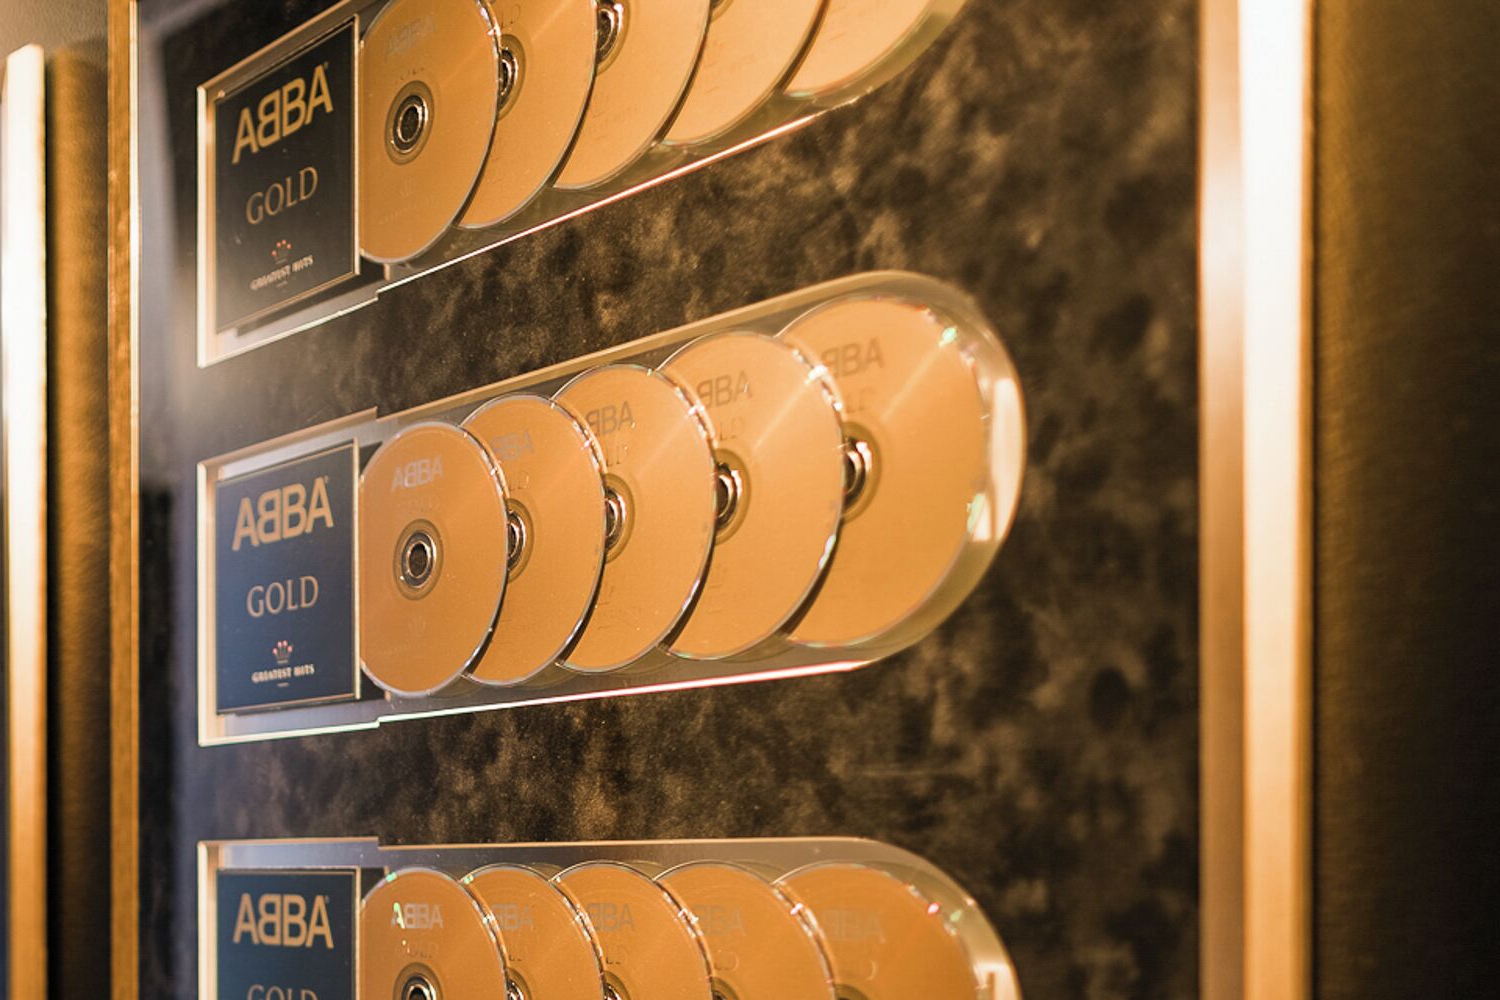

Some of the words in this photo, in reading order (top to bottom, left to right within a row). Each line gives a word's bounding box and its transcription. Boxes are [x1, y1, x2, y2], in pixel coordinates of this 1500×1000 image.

[232, 63, 334, 164] ABBA
[246, 166, 319, 225] GOLD
[822, 337, 885, 379] BBA
[698, 370, 752, 410] BBA
[585, 400, 635, 438] BBA
[390, 455, 445, 493] ABBA
[232, 475, 334, 551] ABBA
[246, 575, 319, 618] GOLD
[233, 893, 334, 949] ABBA
[391, 902, 444, 930] ABBA
